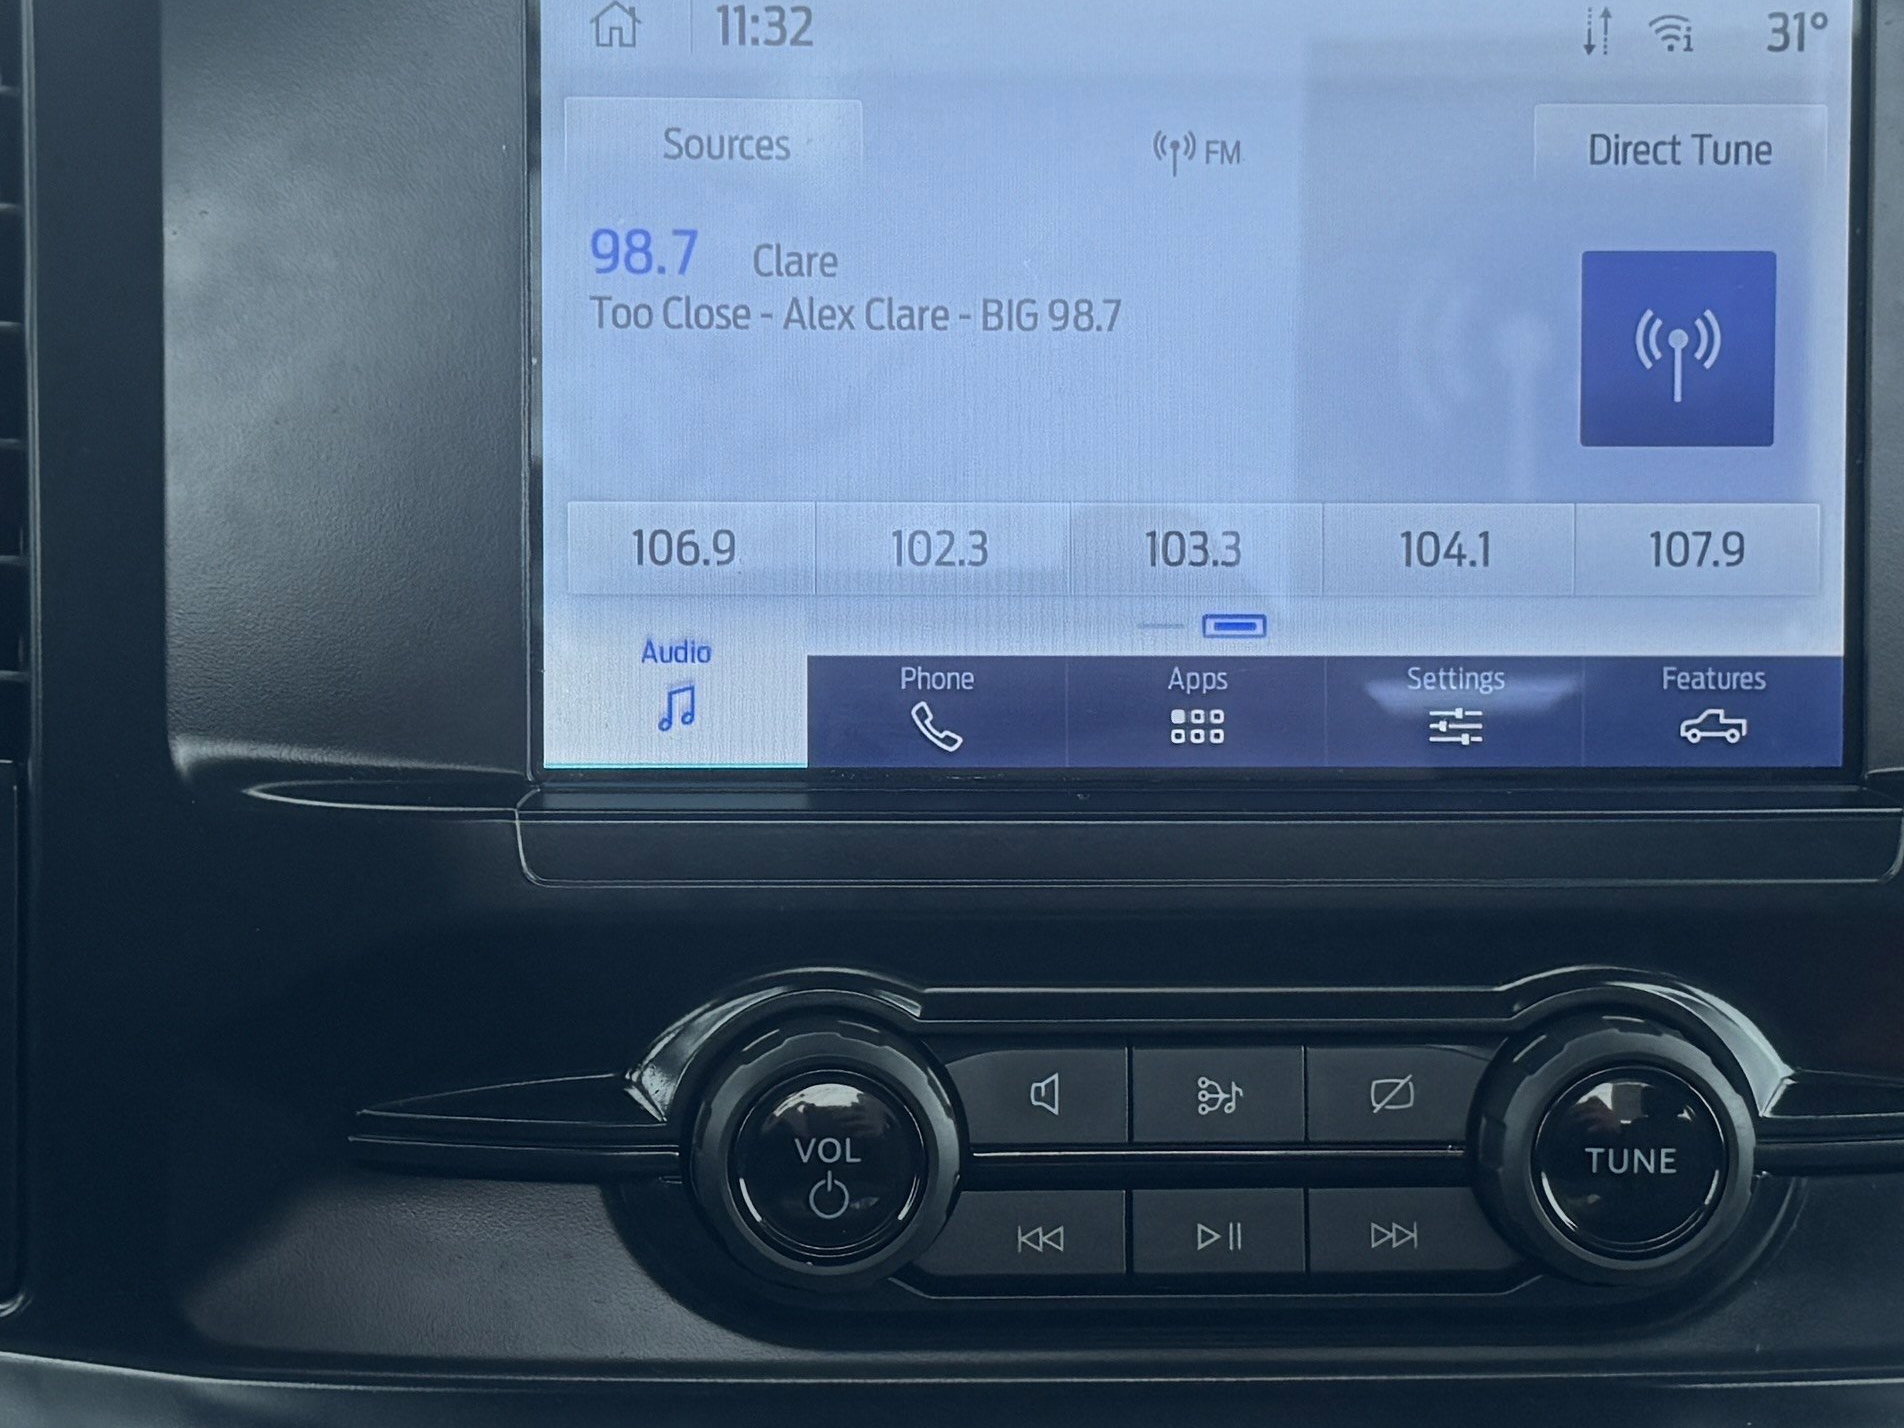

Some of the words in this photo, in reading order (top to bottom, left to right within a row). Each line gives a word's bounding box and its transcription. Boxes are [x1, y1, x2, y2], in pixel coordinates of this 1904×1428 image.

[717, 5, 813, 46] 11:32
[663, 127, 790, 160] Sources
[1206, 140, 1241, 164] FM
[1590, 134, 1681, 165] Direct
[1691, 134, 1772, 165] Tune
[591, 228, 698, 275] 98.7
[754, 243, 838, 277] Clare
[590, 296, 653, 329] Too
[663, 295, 751, 330] Close
[783, 296, 855, 330] Alex
[866, 297, 949, 331] Clare
[983, 298, 1038, 331] BIG
[1049, 299, 1121, 332] 98.7
[633, 529, 735, 566] 106.9
[893, 530, 988, 567] 102.3
[1145, 529, 1243, 568] 103.3
[1401, 531, 1489, 567] 104.1
[1651, 531, 1744, 567] 107.9
[642, 638, 712, 663] Audio
[901, 666, 974, 689] Phone
[1168, 665, 1228, 692] Apps
[1407, 667, 1505, 693] Settings
[1663, 667, 1766, 689] Features
[795, 1138, 861, 1163] VOL
[1585, 1148, 1676, 1173] TUNE
